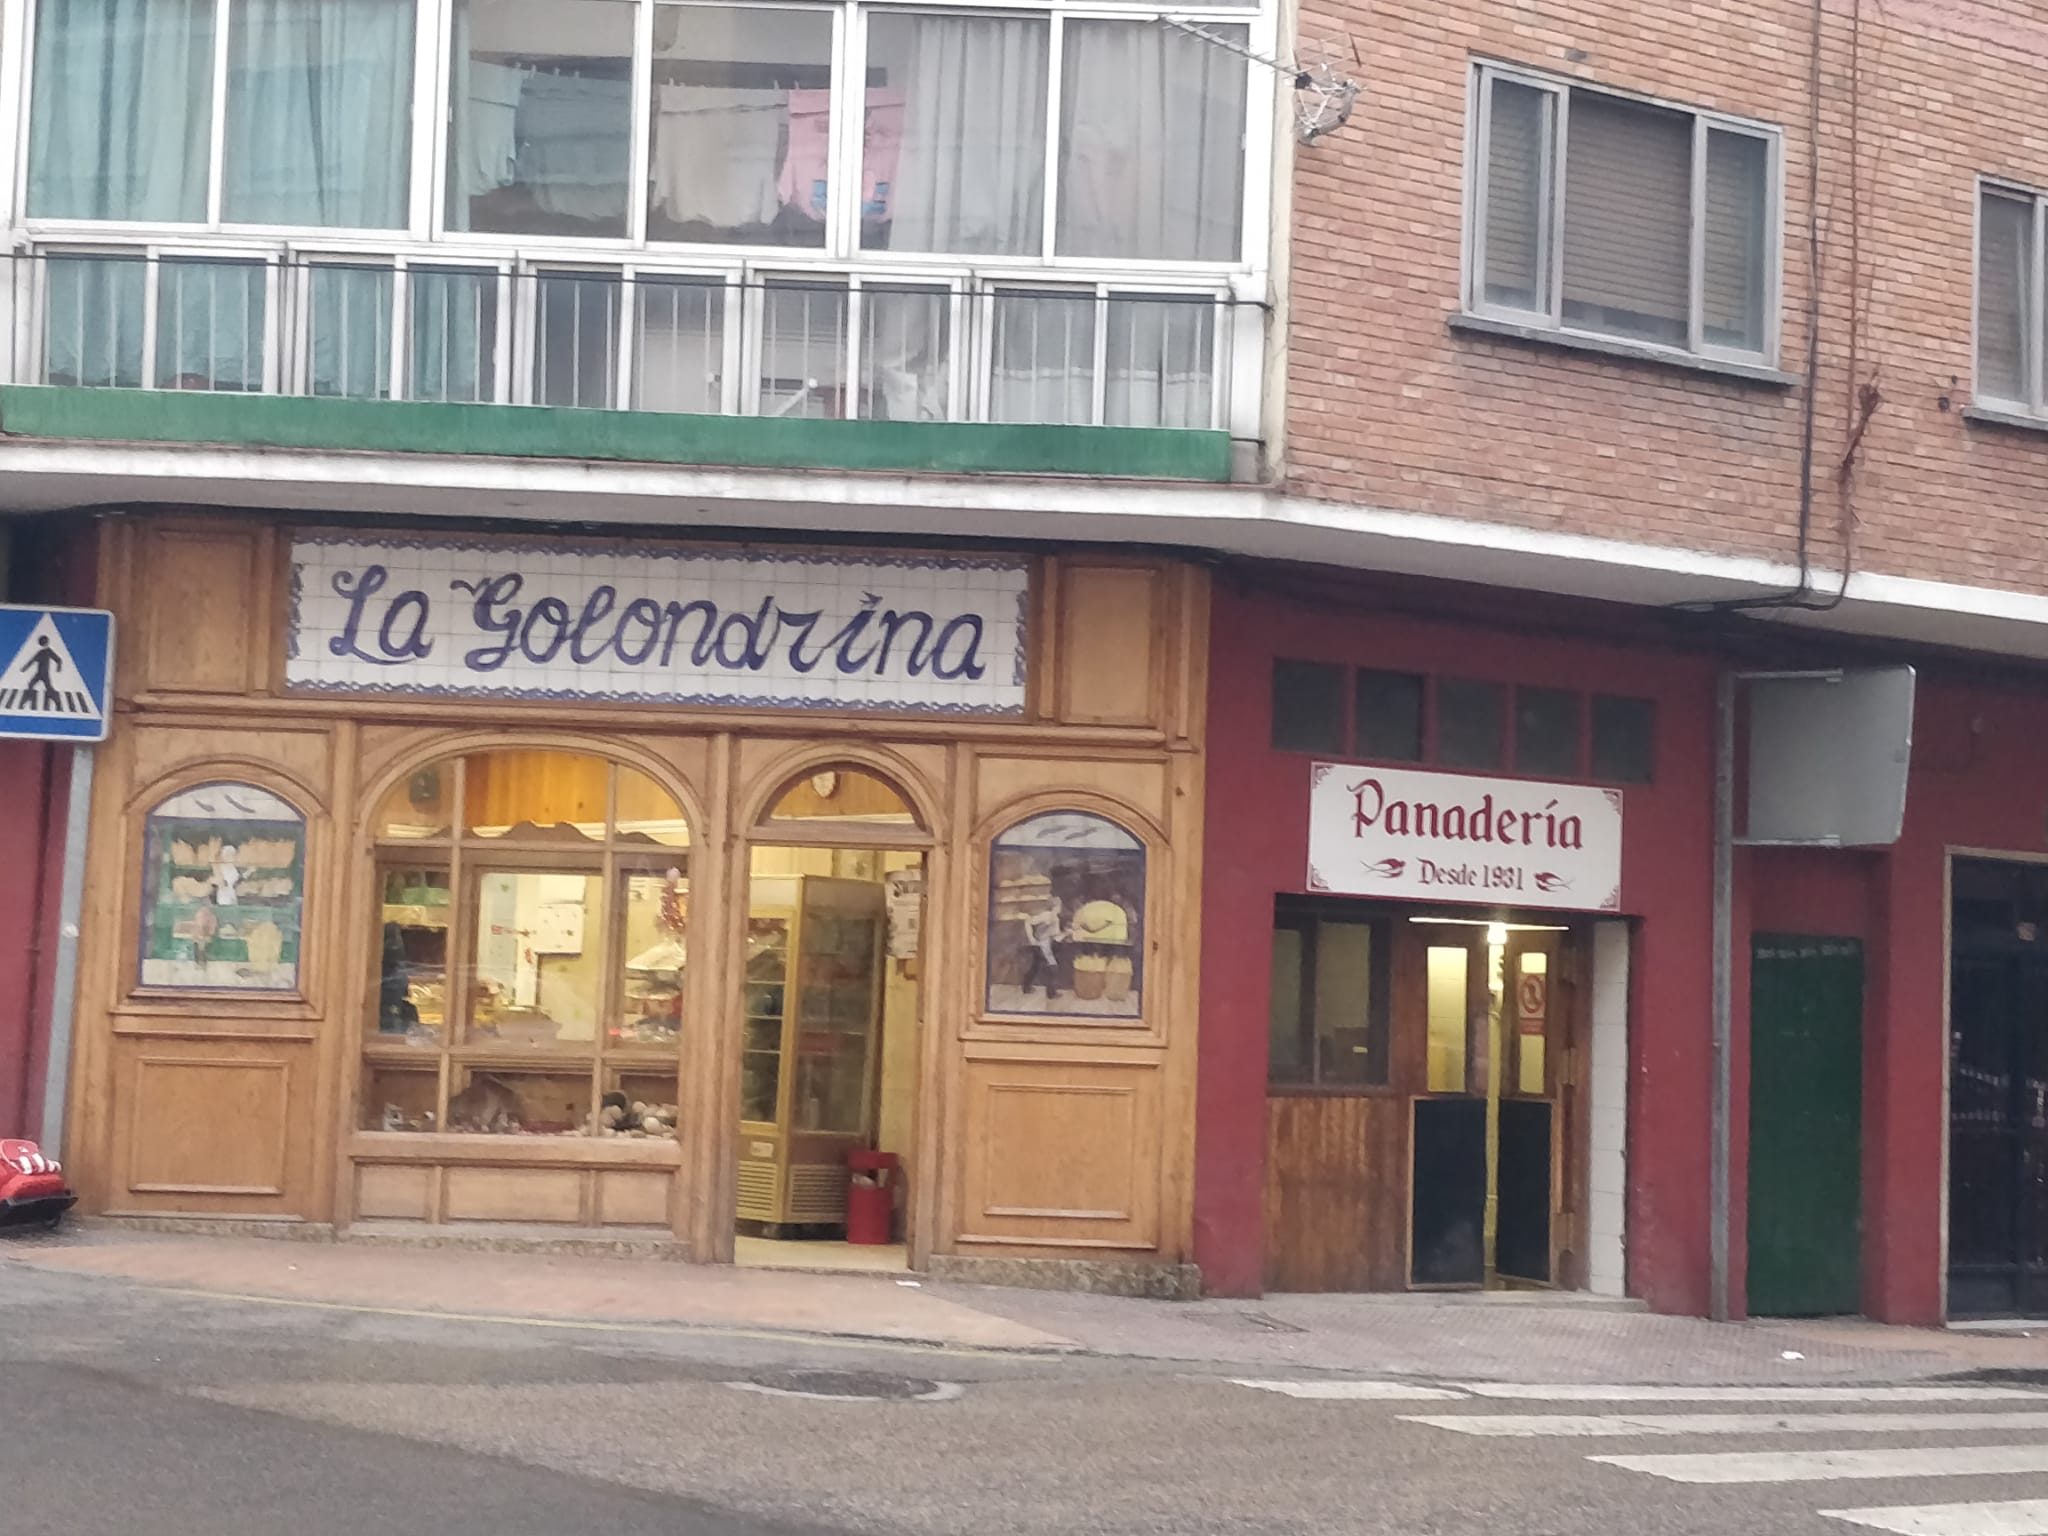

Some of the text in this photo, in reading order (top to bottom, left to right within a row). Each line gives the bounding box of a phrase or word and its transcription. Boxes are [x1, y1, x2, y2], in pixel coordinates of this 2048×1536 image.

[329, 564, 987, 681] La Golondrina
[1346, 778, 1584, 850] Panadería
[1416, 857, 1524, 891] Desde 1931
